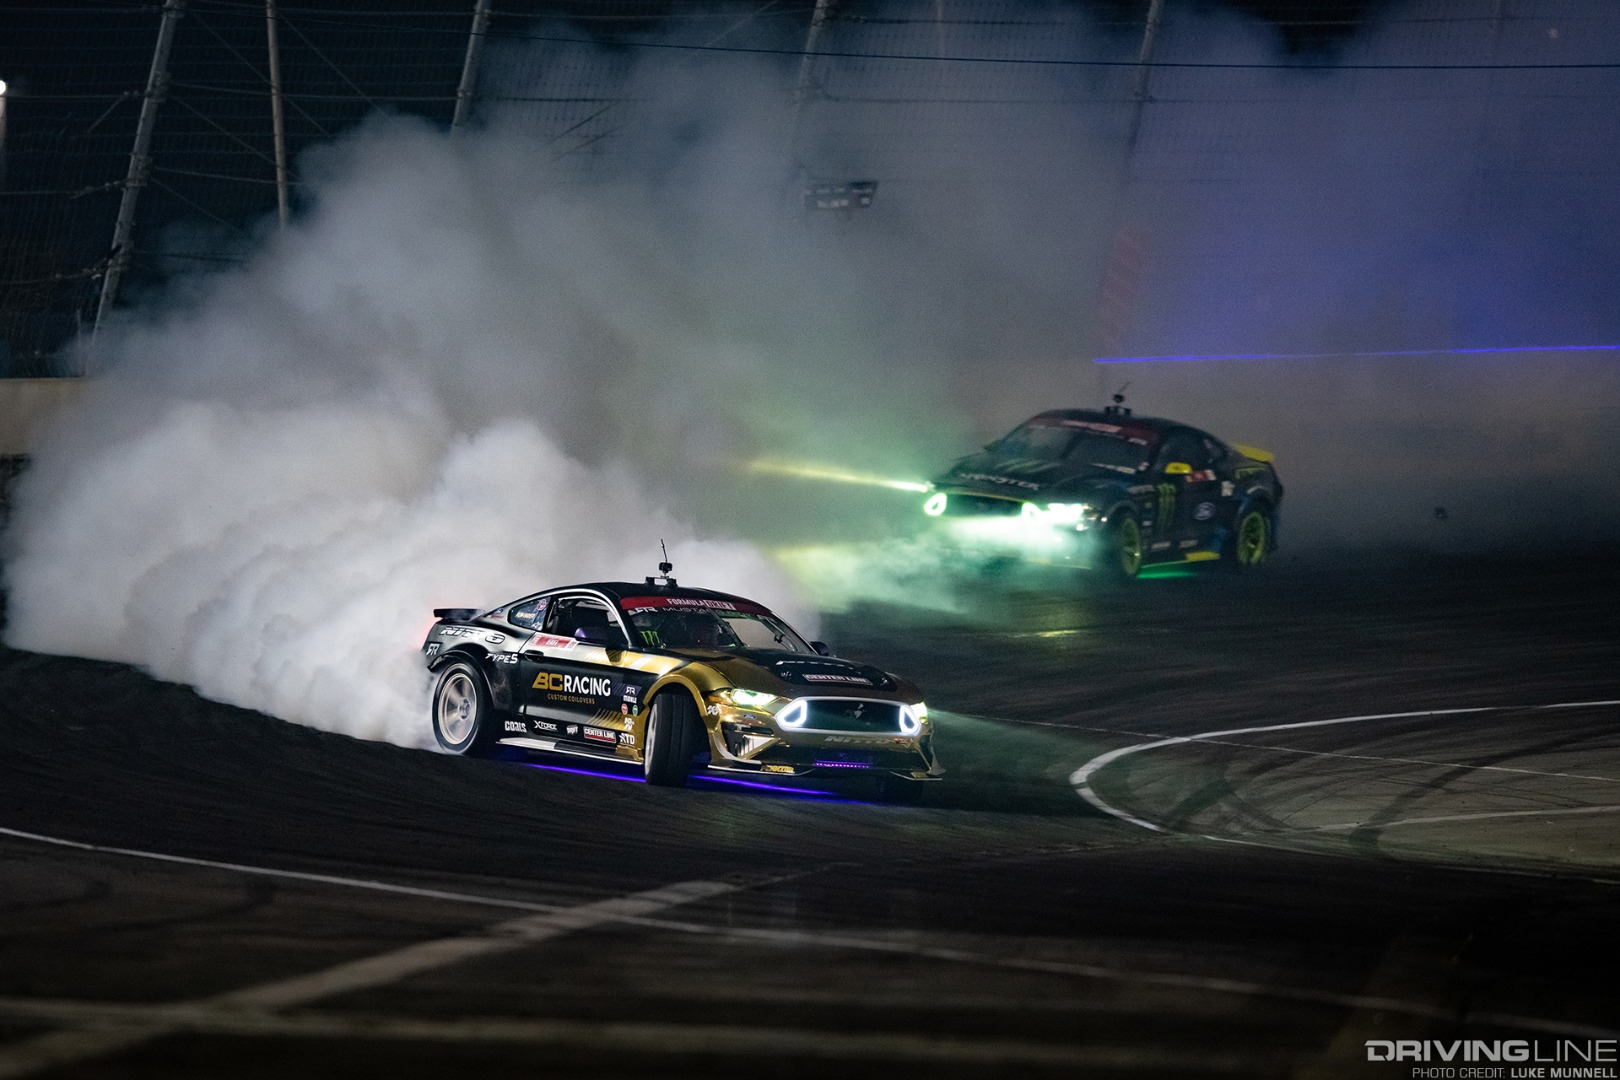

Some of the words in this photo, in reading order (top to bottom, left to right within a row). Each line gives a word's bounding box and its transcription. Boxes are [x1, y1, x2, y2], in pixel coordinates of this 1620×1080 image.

[667, 598, 703, 606] FORMULA
[547, 693, 567, 702] CUSTOM
[568, 696, 596, 704] COILOVERS
[583, 728, 604, 737] CENTER
[604, 731, 616, 739] LINE
